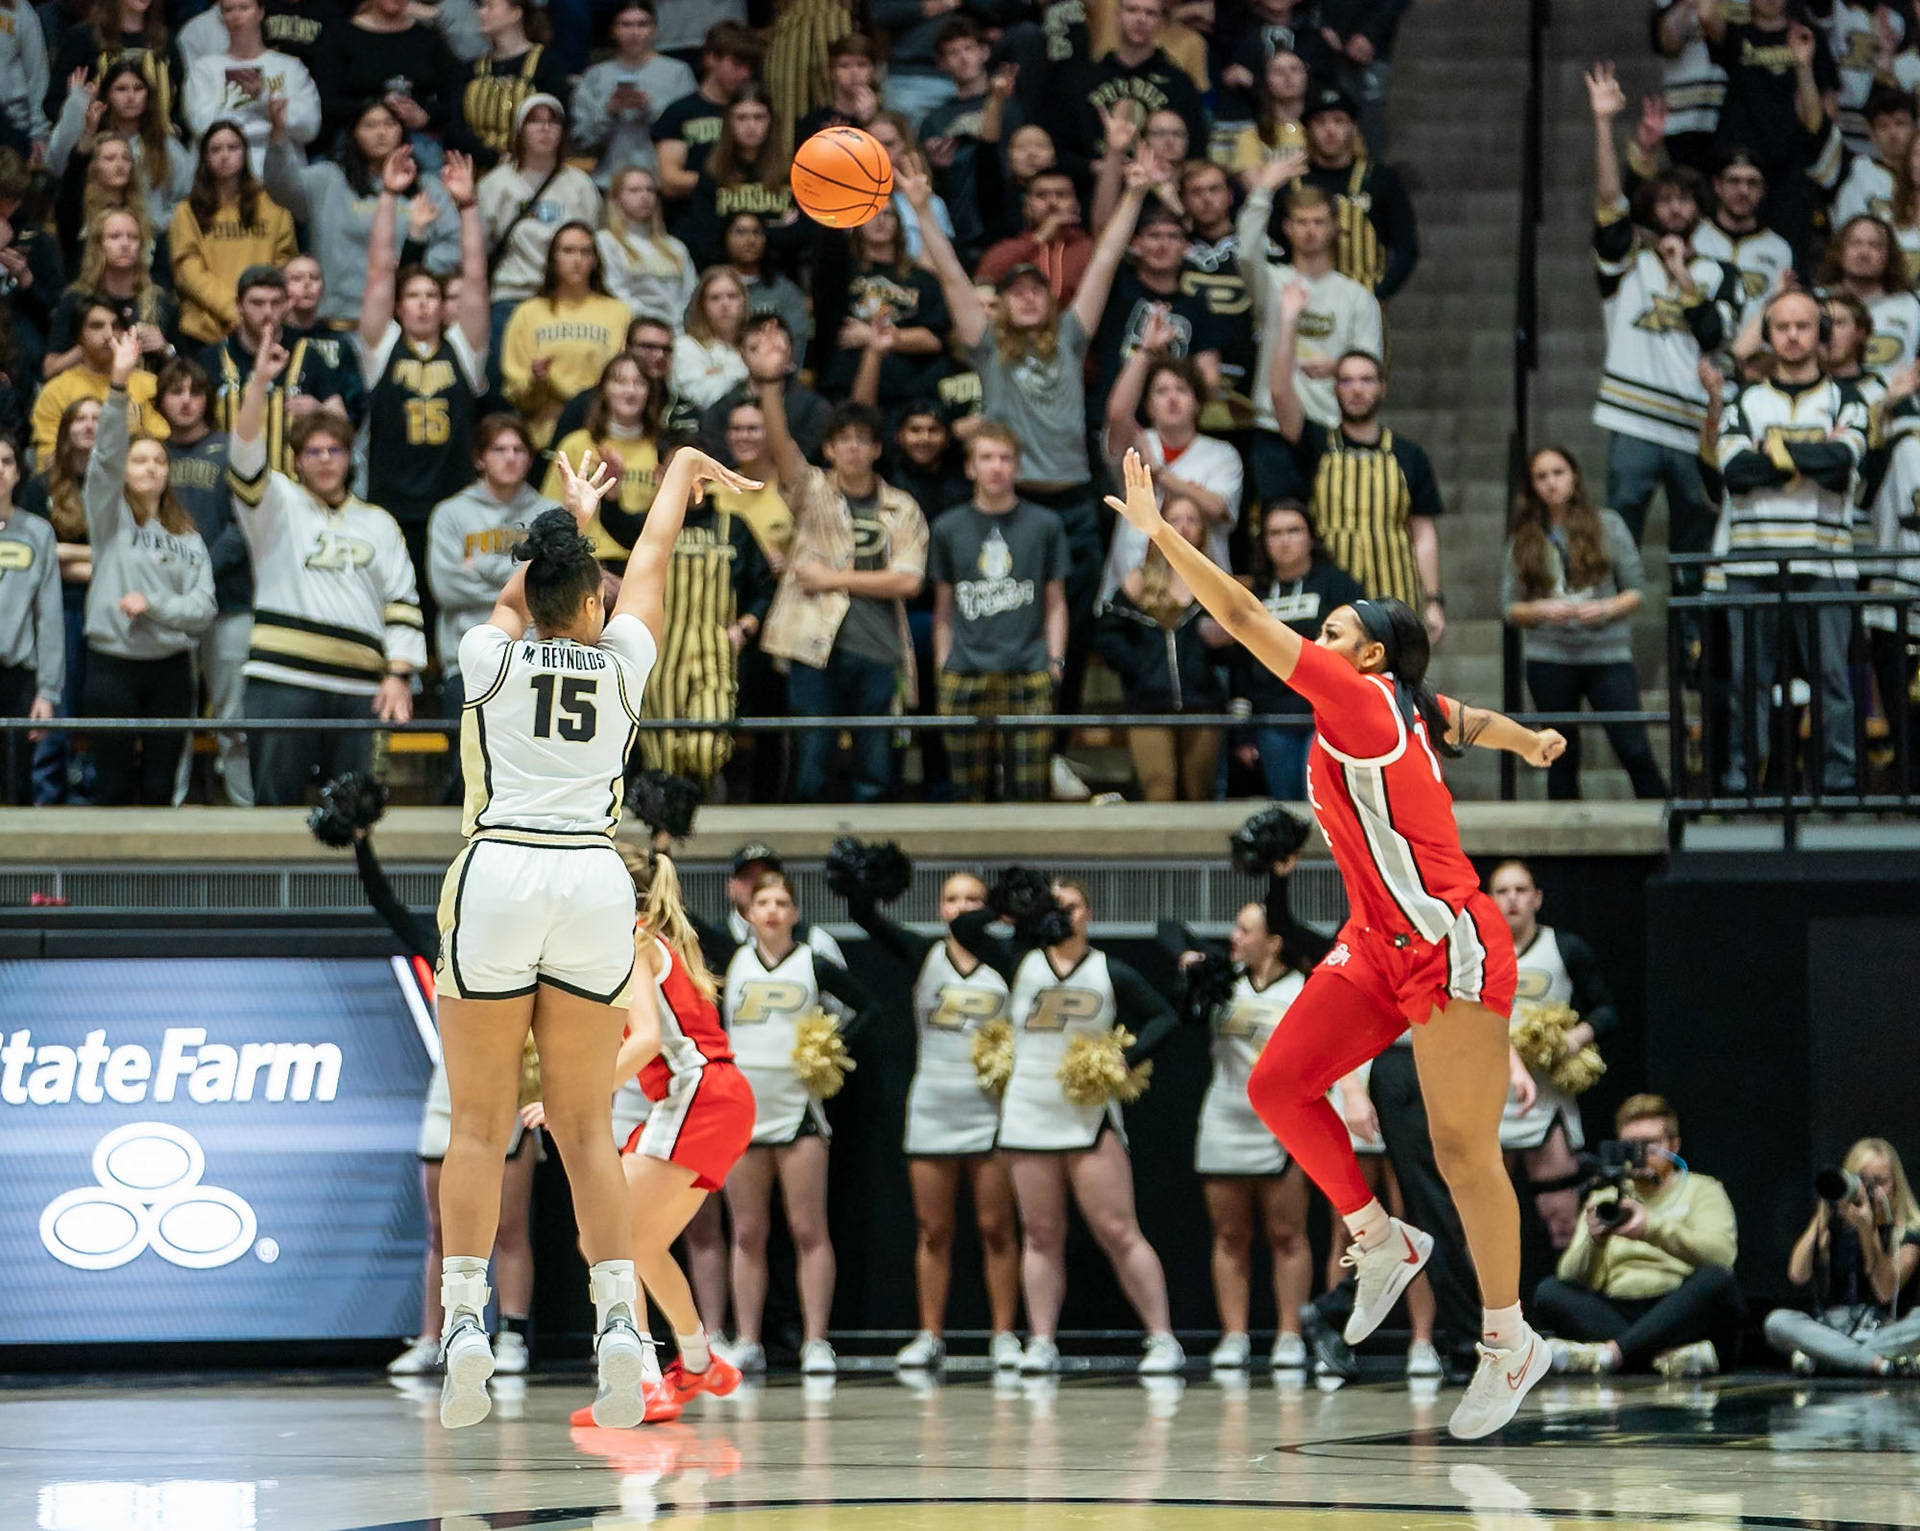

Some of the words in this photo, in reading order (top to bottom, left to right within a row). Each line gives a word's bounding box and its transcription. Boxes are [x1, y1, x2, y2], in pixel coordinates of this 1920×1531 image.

[534, 321, 611, 348] PURDUE
[541, 646, 606, 671] REYNOLDS
[530, 673, 598, 743] 15
[733, 980, 809, 1026] P
[928, 985, 1005, 1031] P
[1025, 986, 1103, 1032] P
[0, 1028, 151, 1105] tate
[154, 1027, 342, 1102] Farm
